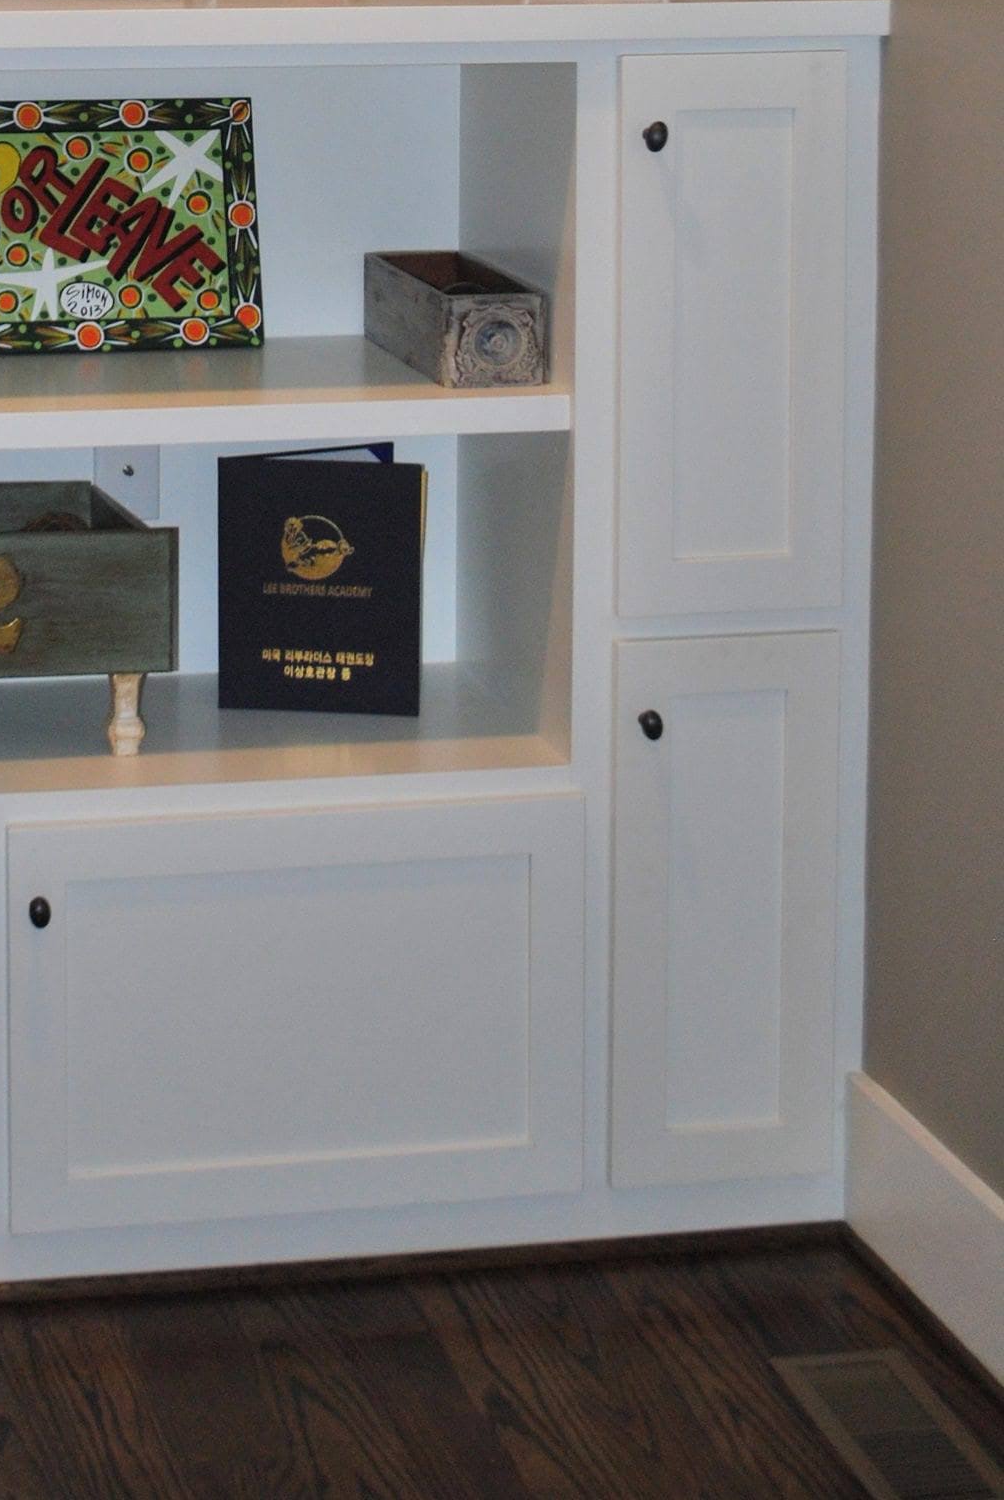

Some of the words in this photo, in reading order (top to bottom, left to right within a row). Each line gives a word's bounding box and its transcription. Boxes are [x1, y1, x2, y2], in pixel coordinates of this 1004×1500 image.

[0, 145, 76, 234] OR
[39, 157, 227, 313] LEAVE
[67, 301, 103, 318] 2013
